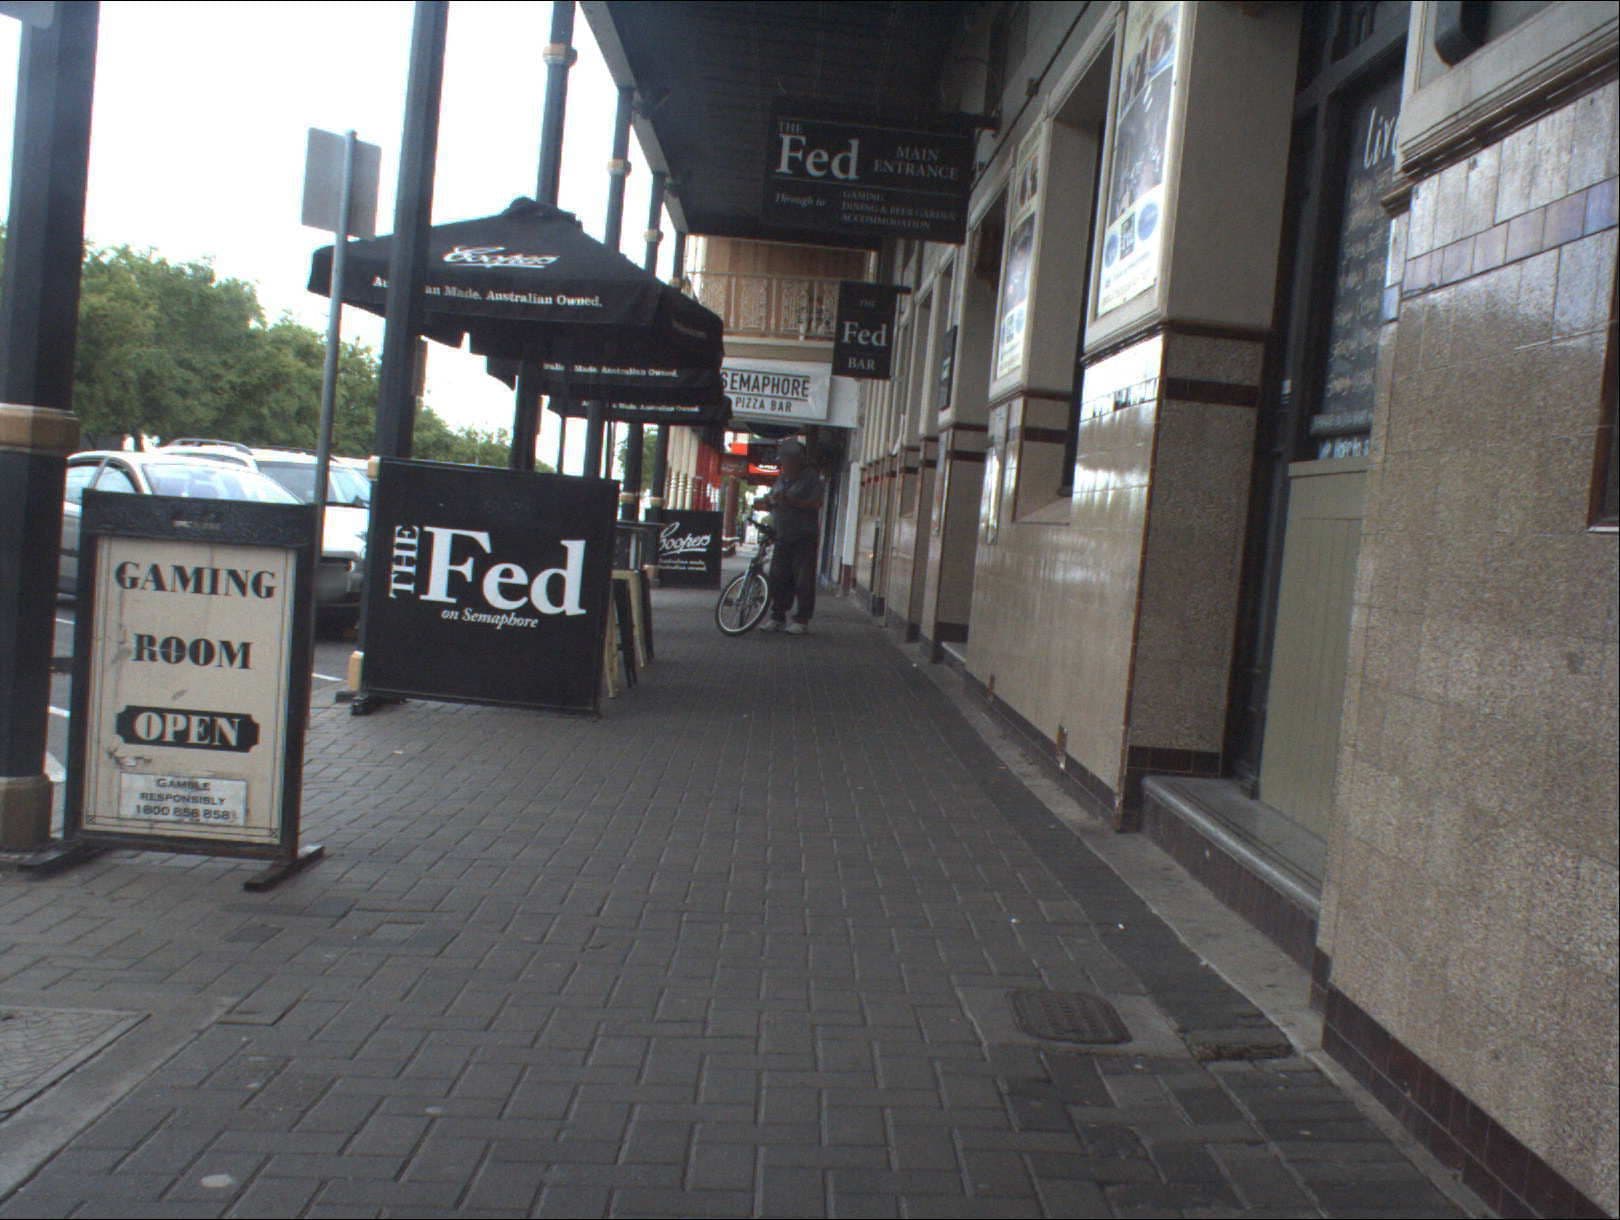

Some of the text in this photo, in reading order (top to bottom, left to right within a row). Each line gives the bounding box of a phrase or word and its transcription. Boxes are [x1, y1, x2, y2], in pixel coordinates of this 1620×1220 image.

[775, 133, 861, 180] Fed
[895, 144, 940, 161] MAIN
[873, 159, 959, 181] ENTRANCE
[486, 289, 552, 306] Australian
[556, 293, 603, 309] Owned.
[841, 320, 888, 348] Fed
[847, 357, 876, 371] BAR
[719, 371, 811, 398] SEMAPHORE
[735, 396, 793, 412] PIZZA BAR
[115, 560, 276, 599] GAMING
[388, 524, 587, 617] THE Fed
[440, 607, 540, 630] on Semaphore
[131, 633, 252, 671] ROOM
[134, 714, 242, 746] OPEN
[155, 778, 211, 791] GAMBLE
[135, 804, 170, 816] 1800
[139, 792, 227, 806] RESPONSIBLY
